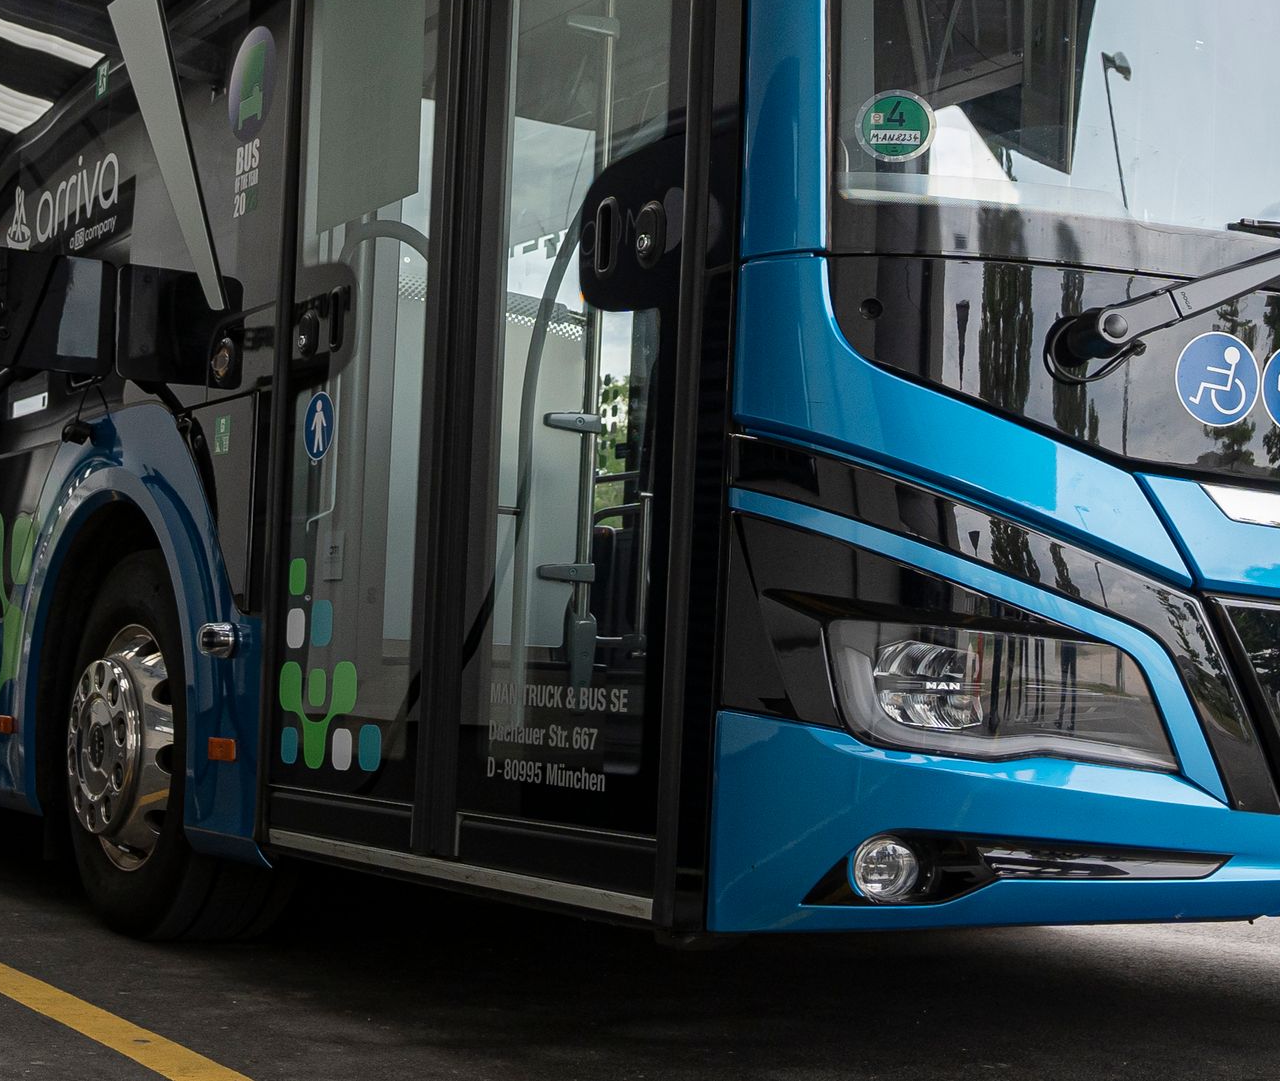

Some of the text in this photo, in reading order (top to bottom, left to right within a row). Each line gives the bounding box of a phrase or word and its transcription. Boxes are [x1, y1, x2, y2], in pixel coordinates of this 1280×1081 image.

[886, 101, 906, 127] 4
[235, 138, 260, 176] BUS
[36, 152, 120, 243] arriva
[84, 216, 117, 244] company
[490, 682, 628, 713] MAN TRUCK & BUS SE
[925, 681, 961, 691] MAN
[488, 720, 598, 751] Dachauer Str. 667
[546, 763, 606, 792] München
